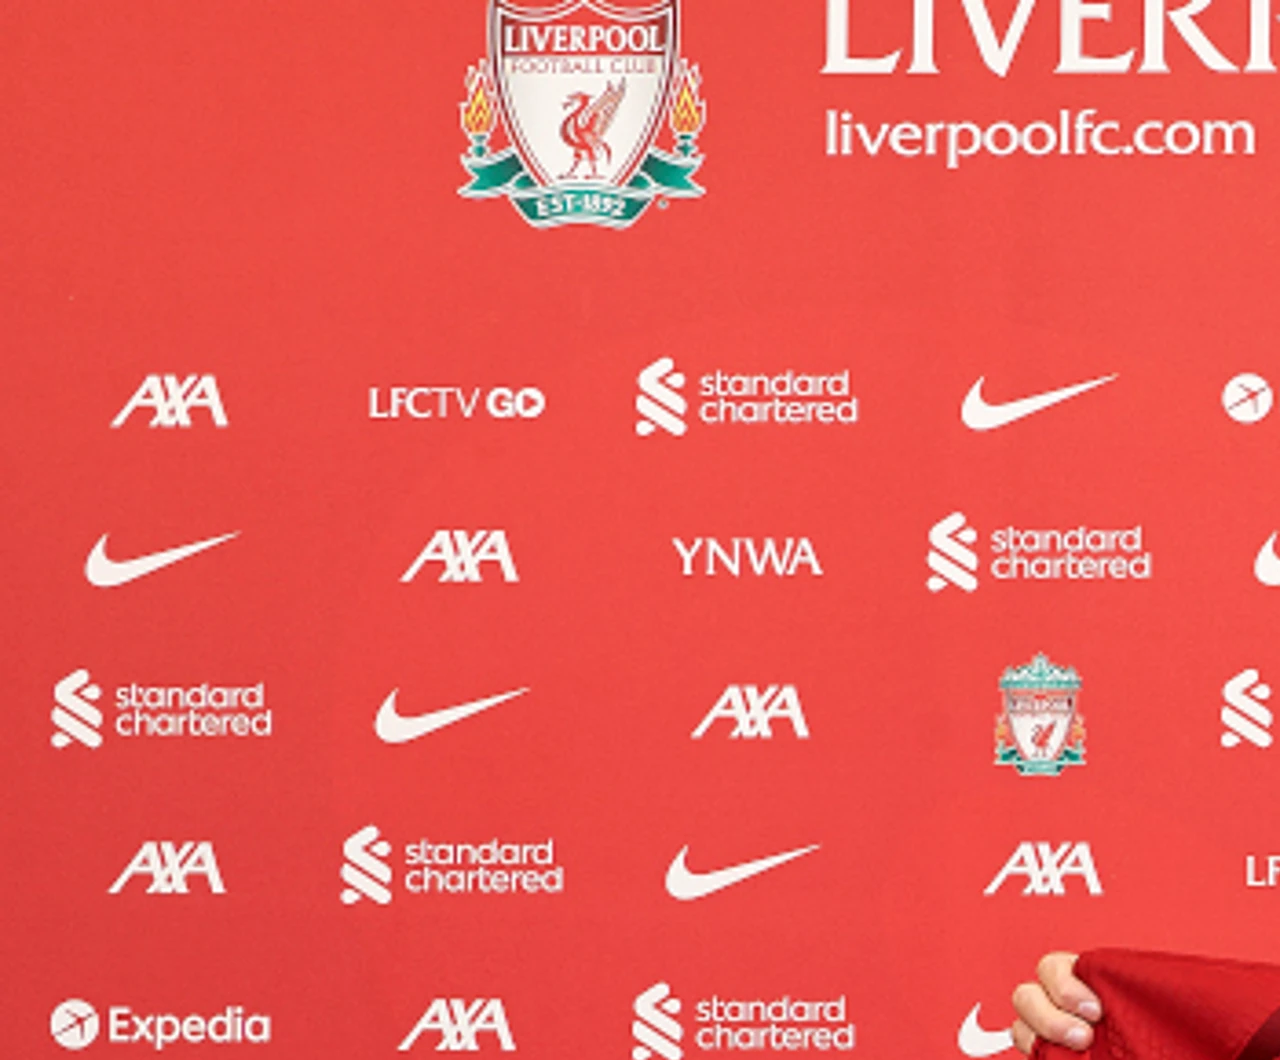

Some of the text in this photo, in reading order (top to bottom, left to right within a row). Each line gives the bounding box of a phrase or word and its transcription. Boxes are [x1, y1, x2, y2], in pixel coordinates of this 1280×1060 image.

[503, 25, 664, 51] LIVERPOOL
[510, 58, 656, 73] FOOTBALL CLUB
[826, 109, 1255, 169] liverpoolfc.com
[699, 370, 849, 396] standard
[111, 374, 228, 428] AXA
[486, 387, 545, 418] GO
[698, 396, 858, 424] chartered
[991, 526, 1149, 553] standard
[400, 530, 519, 582] AXA
[672, 537, 823, 577] YNWA
[991, 553, 1152, 579] chartered
[116, 683, 264, 710] standard
[115, 710, 272, 736] chartered
[691, 684, 809, 739] AXA
[405, 838, 553, 865] standard
[108, 841, 226, 894] AXA
[405, 866, 564, 893] chartered
[984, 841, 1103, 896] AXA
[696, 995, 845, 1022] standard
[109, 1006, 271, 1050] Expedia
[397, 998, 516, 1051] AXA
[695, 1024, 855, 1050] chartered
